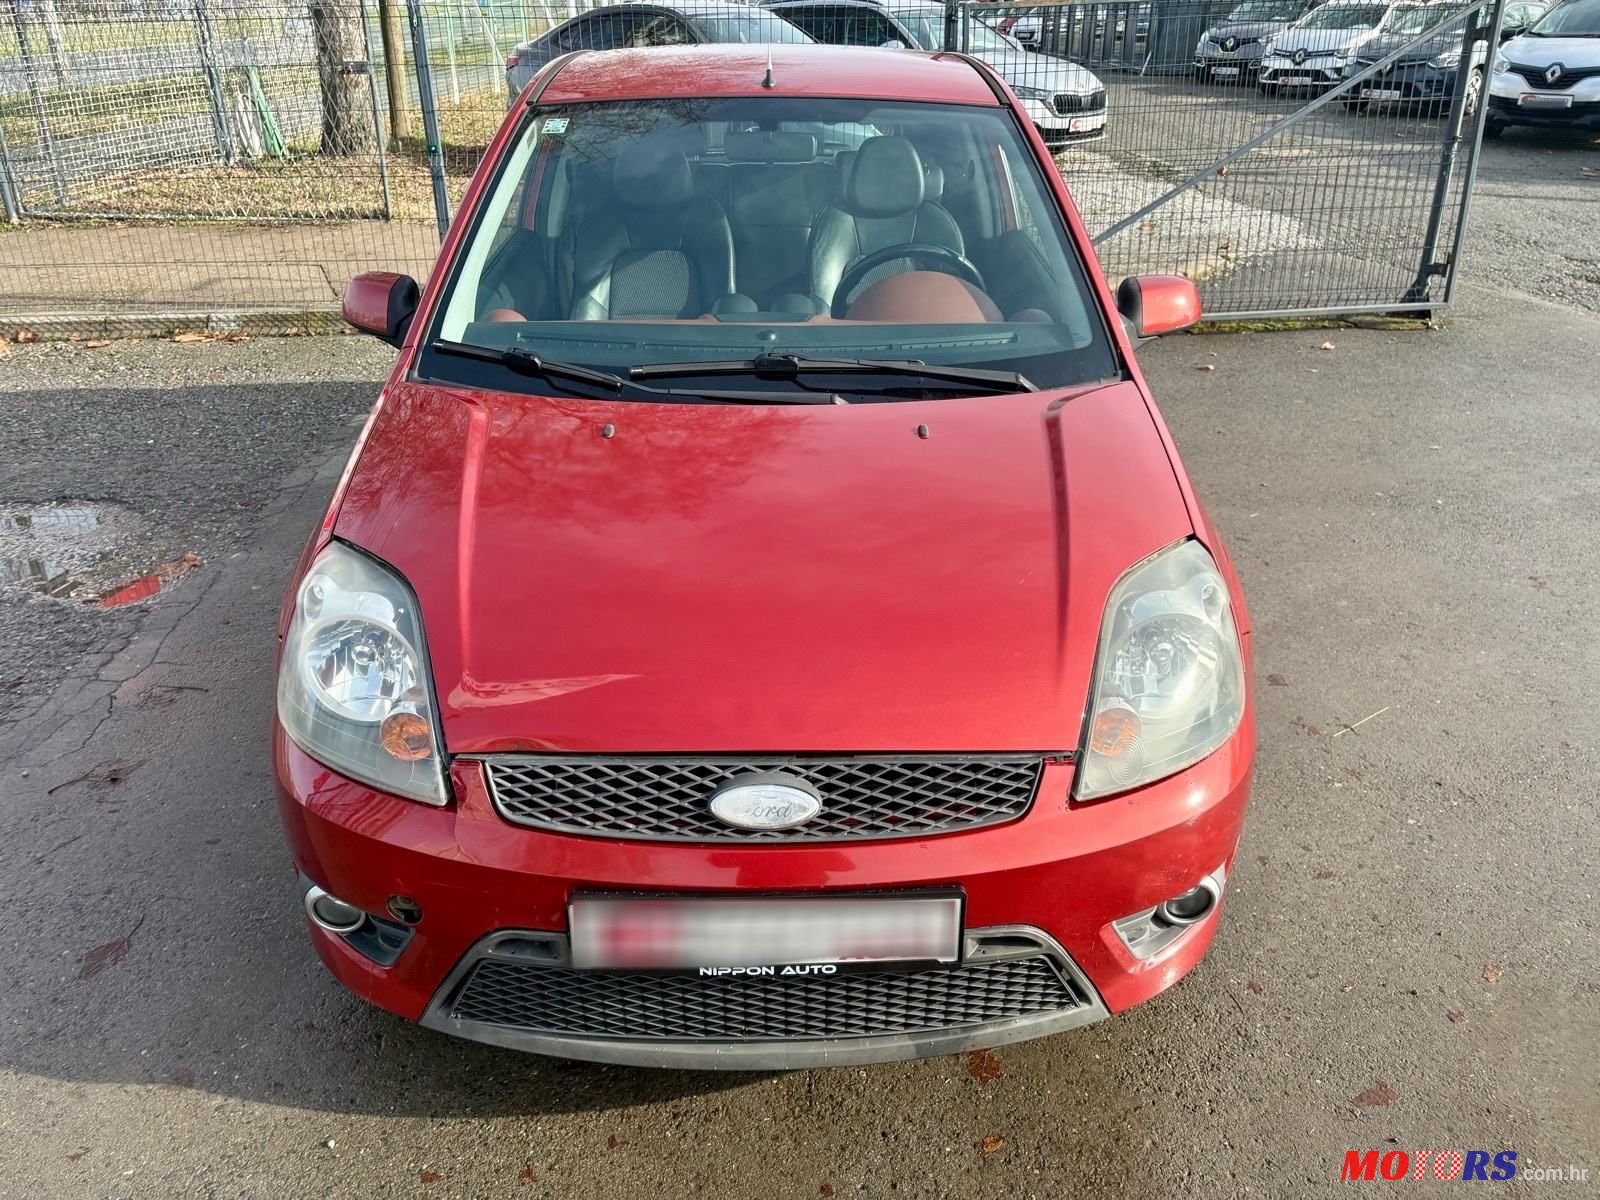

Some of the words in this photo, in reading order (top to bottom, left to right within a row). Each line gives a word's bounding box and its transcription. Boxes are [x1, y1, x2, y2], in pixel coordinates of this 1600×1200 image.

[737, 796, 793, 819] ord
[699, 966, 775, 976] NIPPON
[780, 965, 837, 975] AUTO
